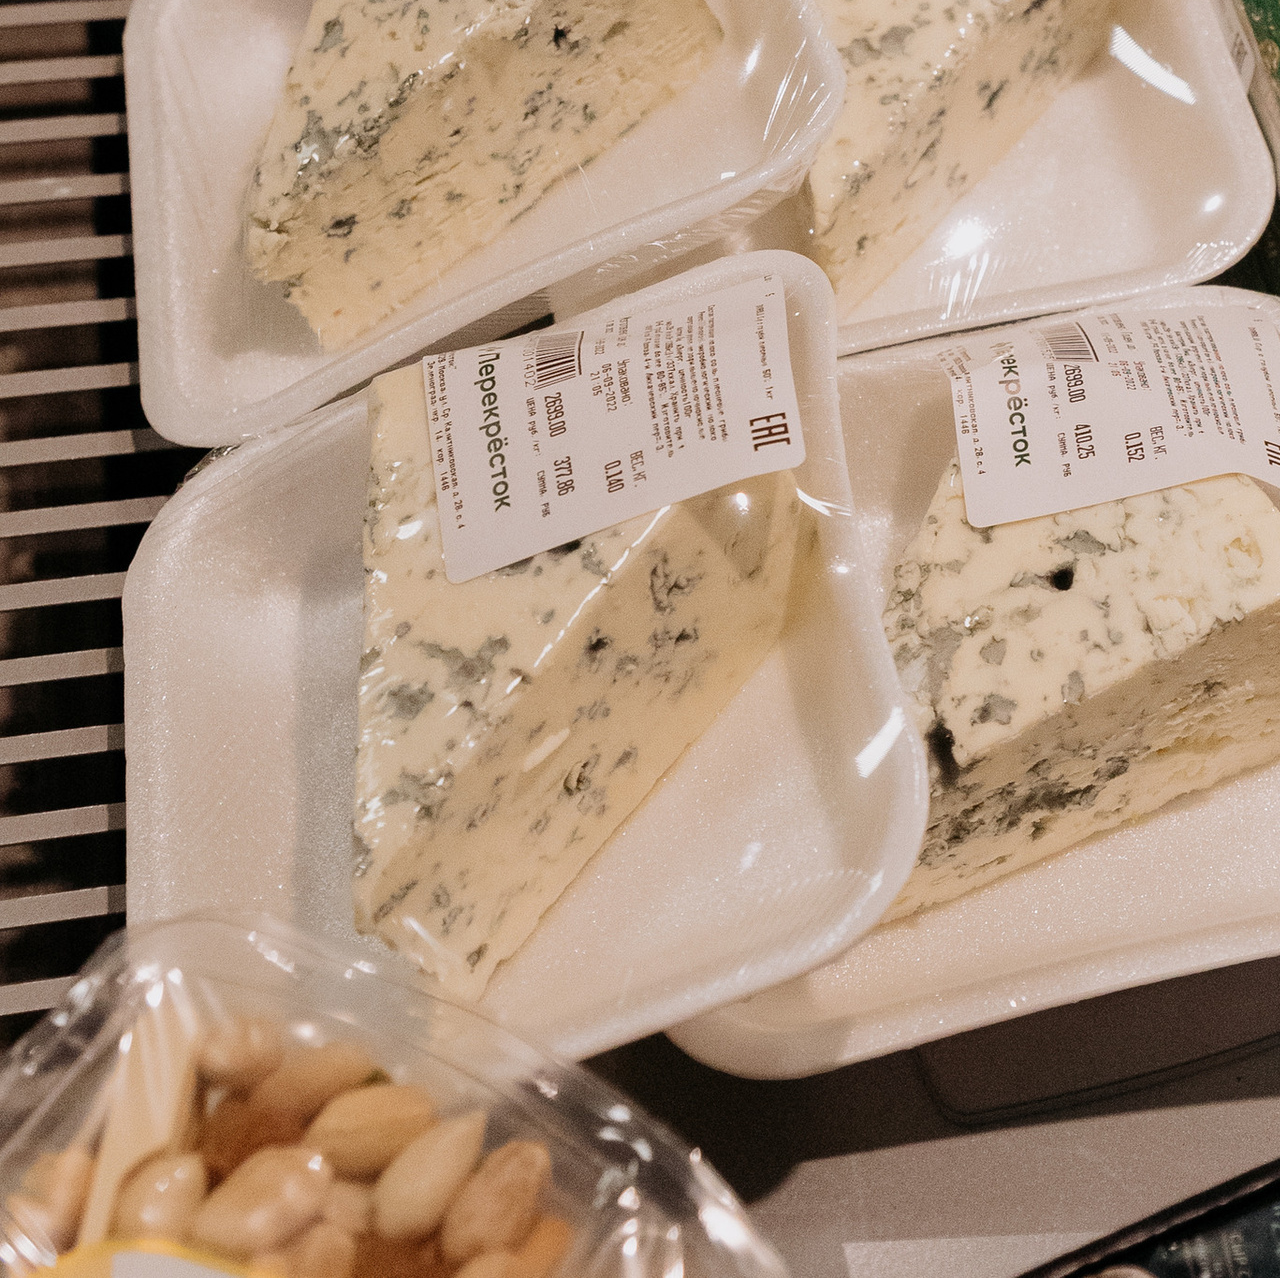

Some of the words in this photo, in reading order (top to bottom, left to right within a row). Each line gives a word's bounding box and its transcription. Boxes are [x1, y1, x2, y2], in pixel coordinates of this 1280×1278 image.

[589, 370, 603, 397] 21:05
[601, 362, 618, 412] 06-09-2022
[616, 359, 632, 403] Упаковано:
[1046, 363, 1056, 382] ЦЕНА
[1063, 364, 1087, 404] 2699.00
[1118, 360, 1137, 391] 06-09-2022
[525, 397, 537, 417] ЦЕНА
[543, 391, 567, 438] 2699.00
[473, 352, 511, 512] Перекрёсток
[674, 425, 683, 441] при
[749, 412, 791, 452] EAC
[1074, 424, 1096, 460] 410.25
[1124, 431, 1146, 463] 0.152
[1153, 444, 1168, 455] КГ.
[553, 455, 576, 497] 377.86
[604, 459, 625, 494] 0.140
[1063, 462, 1072, 478] РУБ
[541, 501, 550, 518] РУБ
